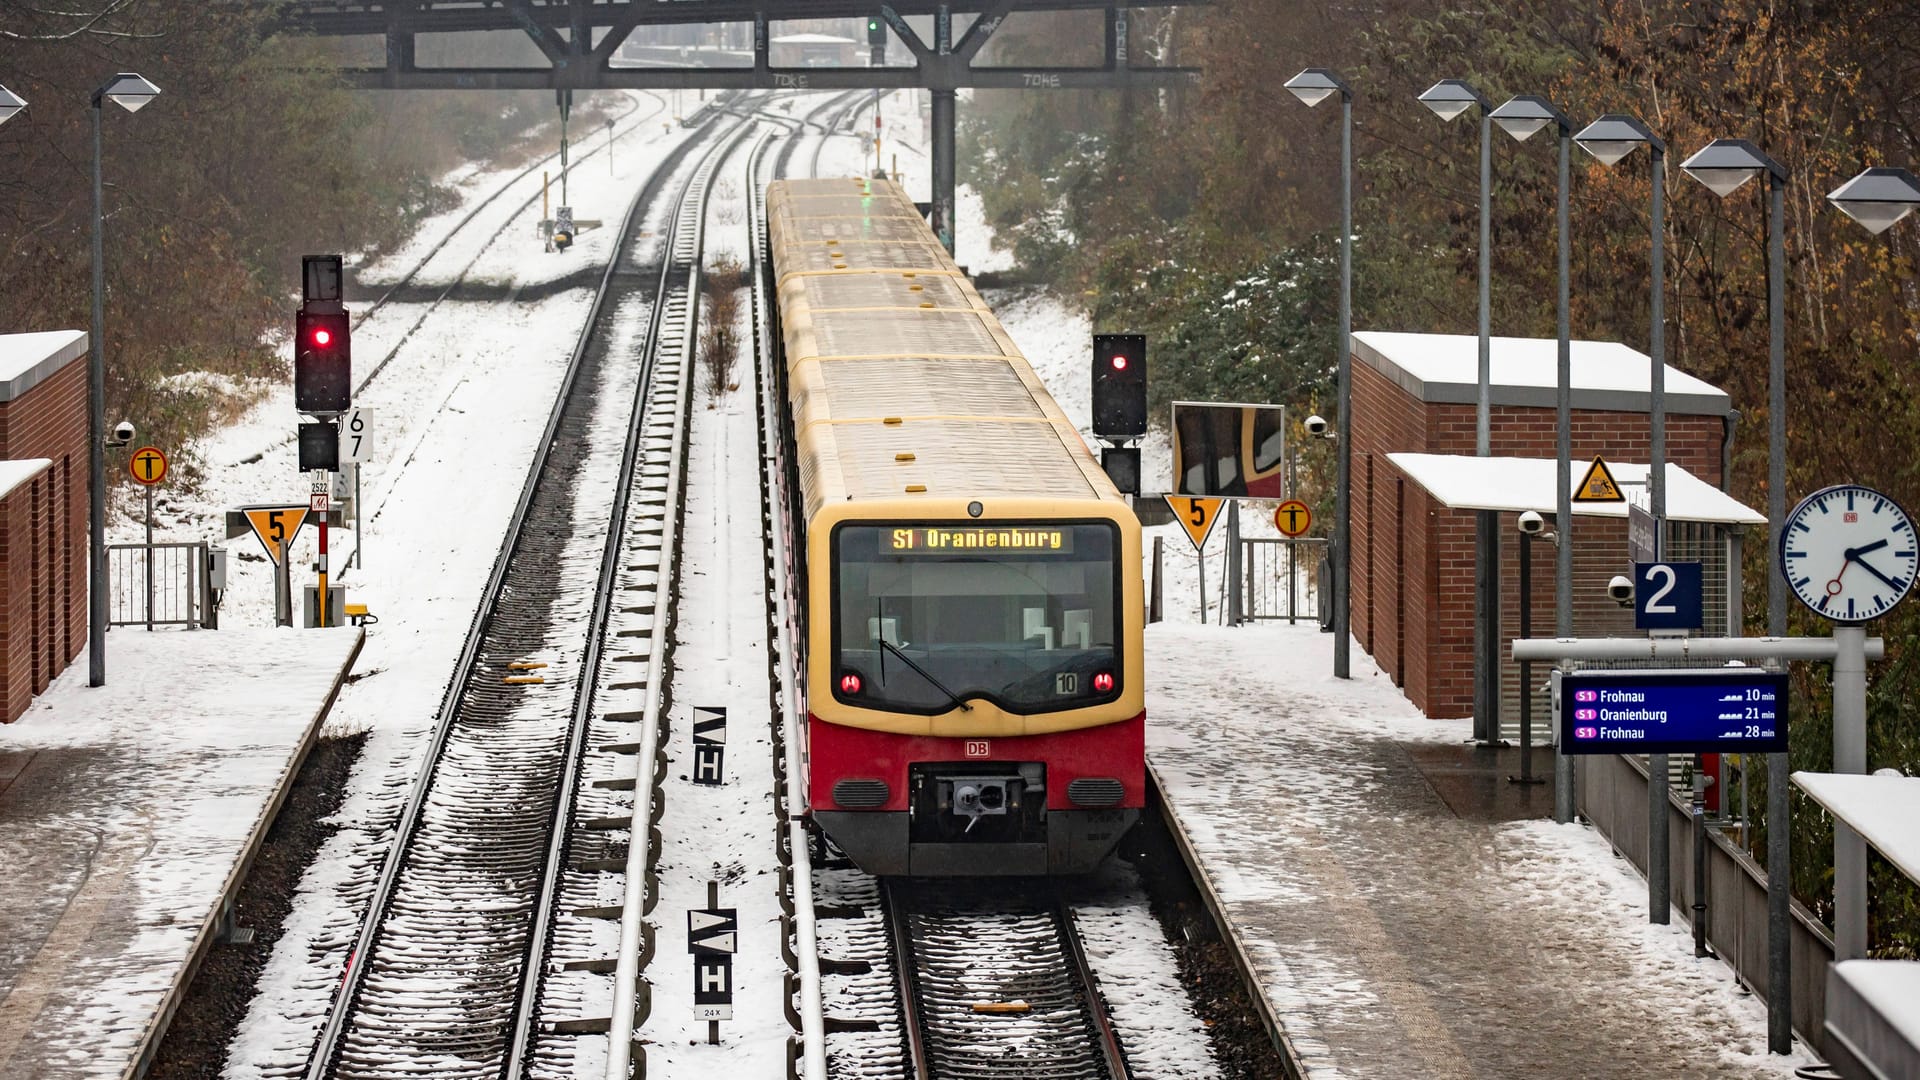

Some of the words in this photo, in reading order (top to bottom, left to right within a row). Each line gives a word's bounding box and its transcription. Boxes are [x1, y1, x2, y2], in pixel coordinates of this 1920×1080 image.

[773, 73, 809, 89] TOKE
[1024, 74, 1061, 88] TOKE
[350, 411, 364, 432] 6
[351, 435, 363, 457] 7
[311, 482, 328, 492] 2522
[1190, 498, 1206, 527] 5
[269, 511, 285, 543] 5
[893, 529, 913, 549] S1
[927, 529, 1062, 549] Oranienburg
[1644, 564, 1677, 614] 2
[1058, 674, 1076, 693] 10
[1600, 690, 1645, 703] Frohnau
[1746, 689, 1761, 701] 10
[1762, 693, 1775, 701] min
[1600, 708, 1667, 723] Oranienburg
[1745, 707, 1760, 719] 21
[1762, 711, 1775, 719] min
[1600, 727, 1645, 739] Frohnau
[1745, 726, 1760, 738] 28
[1762, 729, 1775, 738] min
[967, 742, 988, 756] DB
[698, 751, 719, 780] H
[701, 965, 726, 993] H
